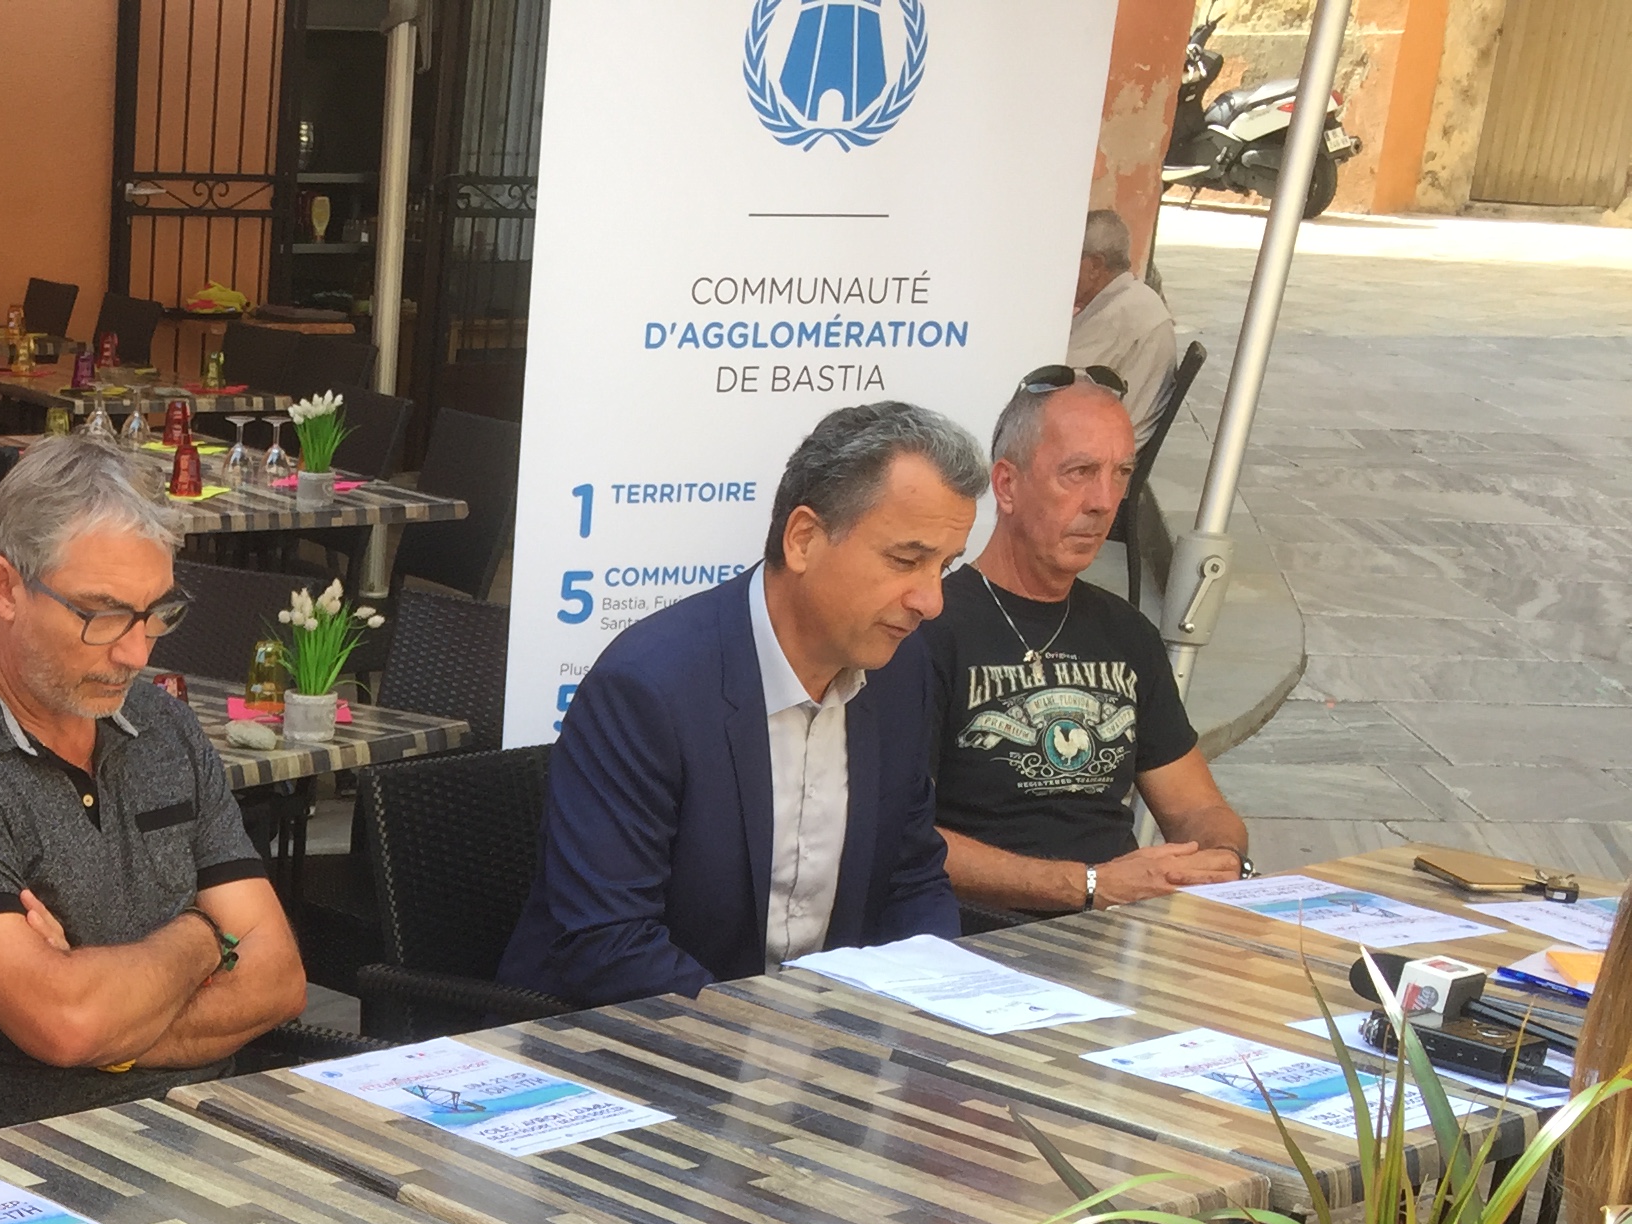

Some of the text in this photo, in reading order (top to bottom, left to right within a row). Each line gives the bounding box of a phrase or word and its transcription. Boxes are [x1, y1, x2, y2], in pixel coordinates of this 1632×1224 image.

[690, 270, 931, 305] COMMUNAUTÉ
[644, 314, 968, 349] D'AGGLOMÉRATION
[716, 364, 886, 393] DE BASTIA
[572, 482, 756, 538] 1 TERRITOIRE
[557, 564, 745, 624] 5 COMMUNES
[600, 617, 639, 631] Sant
[560, 663, 590, 676] Plus
[984, 717, 1030, 738] PREMIUM
